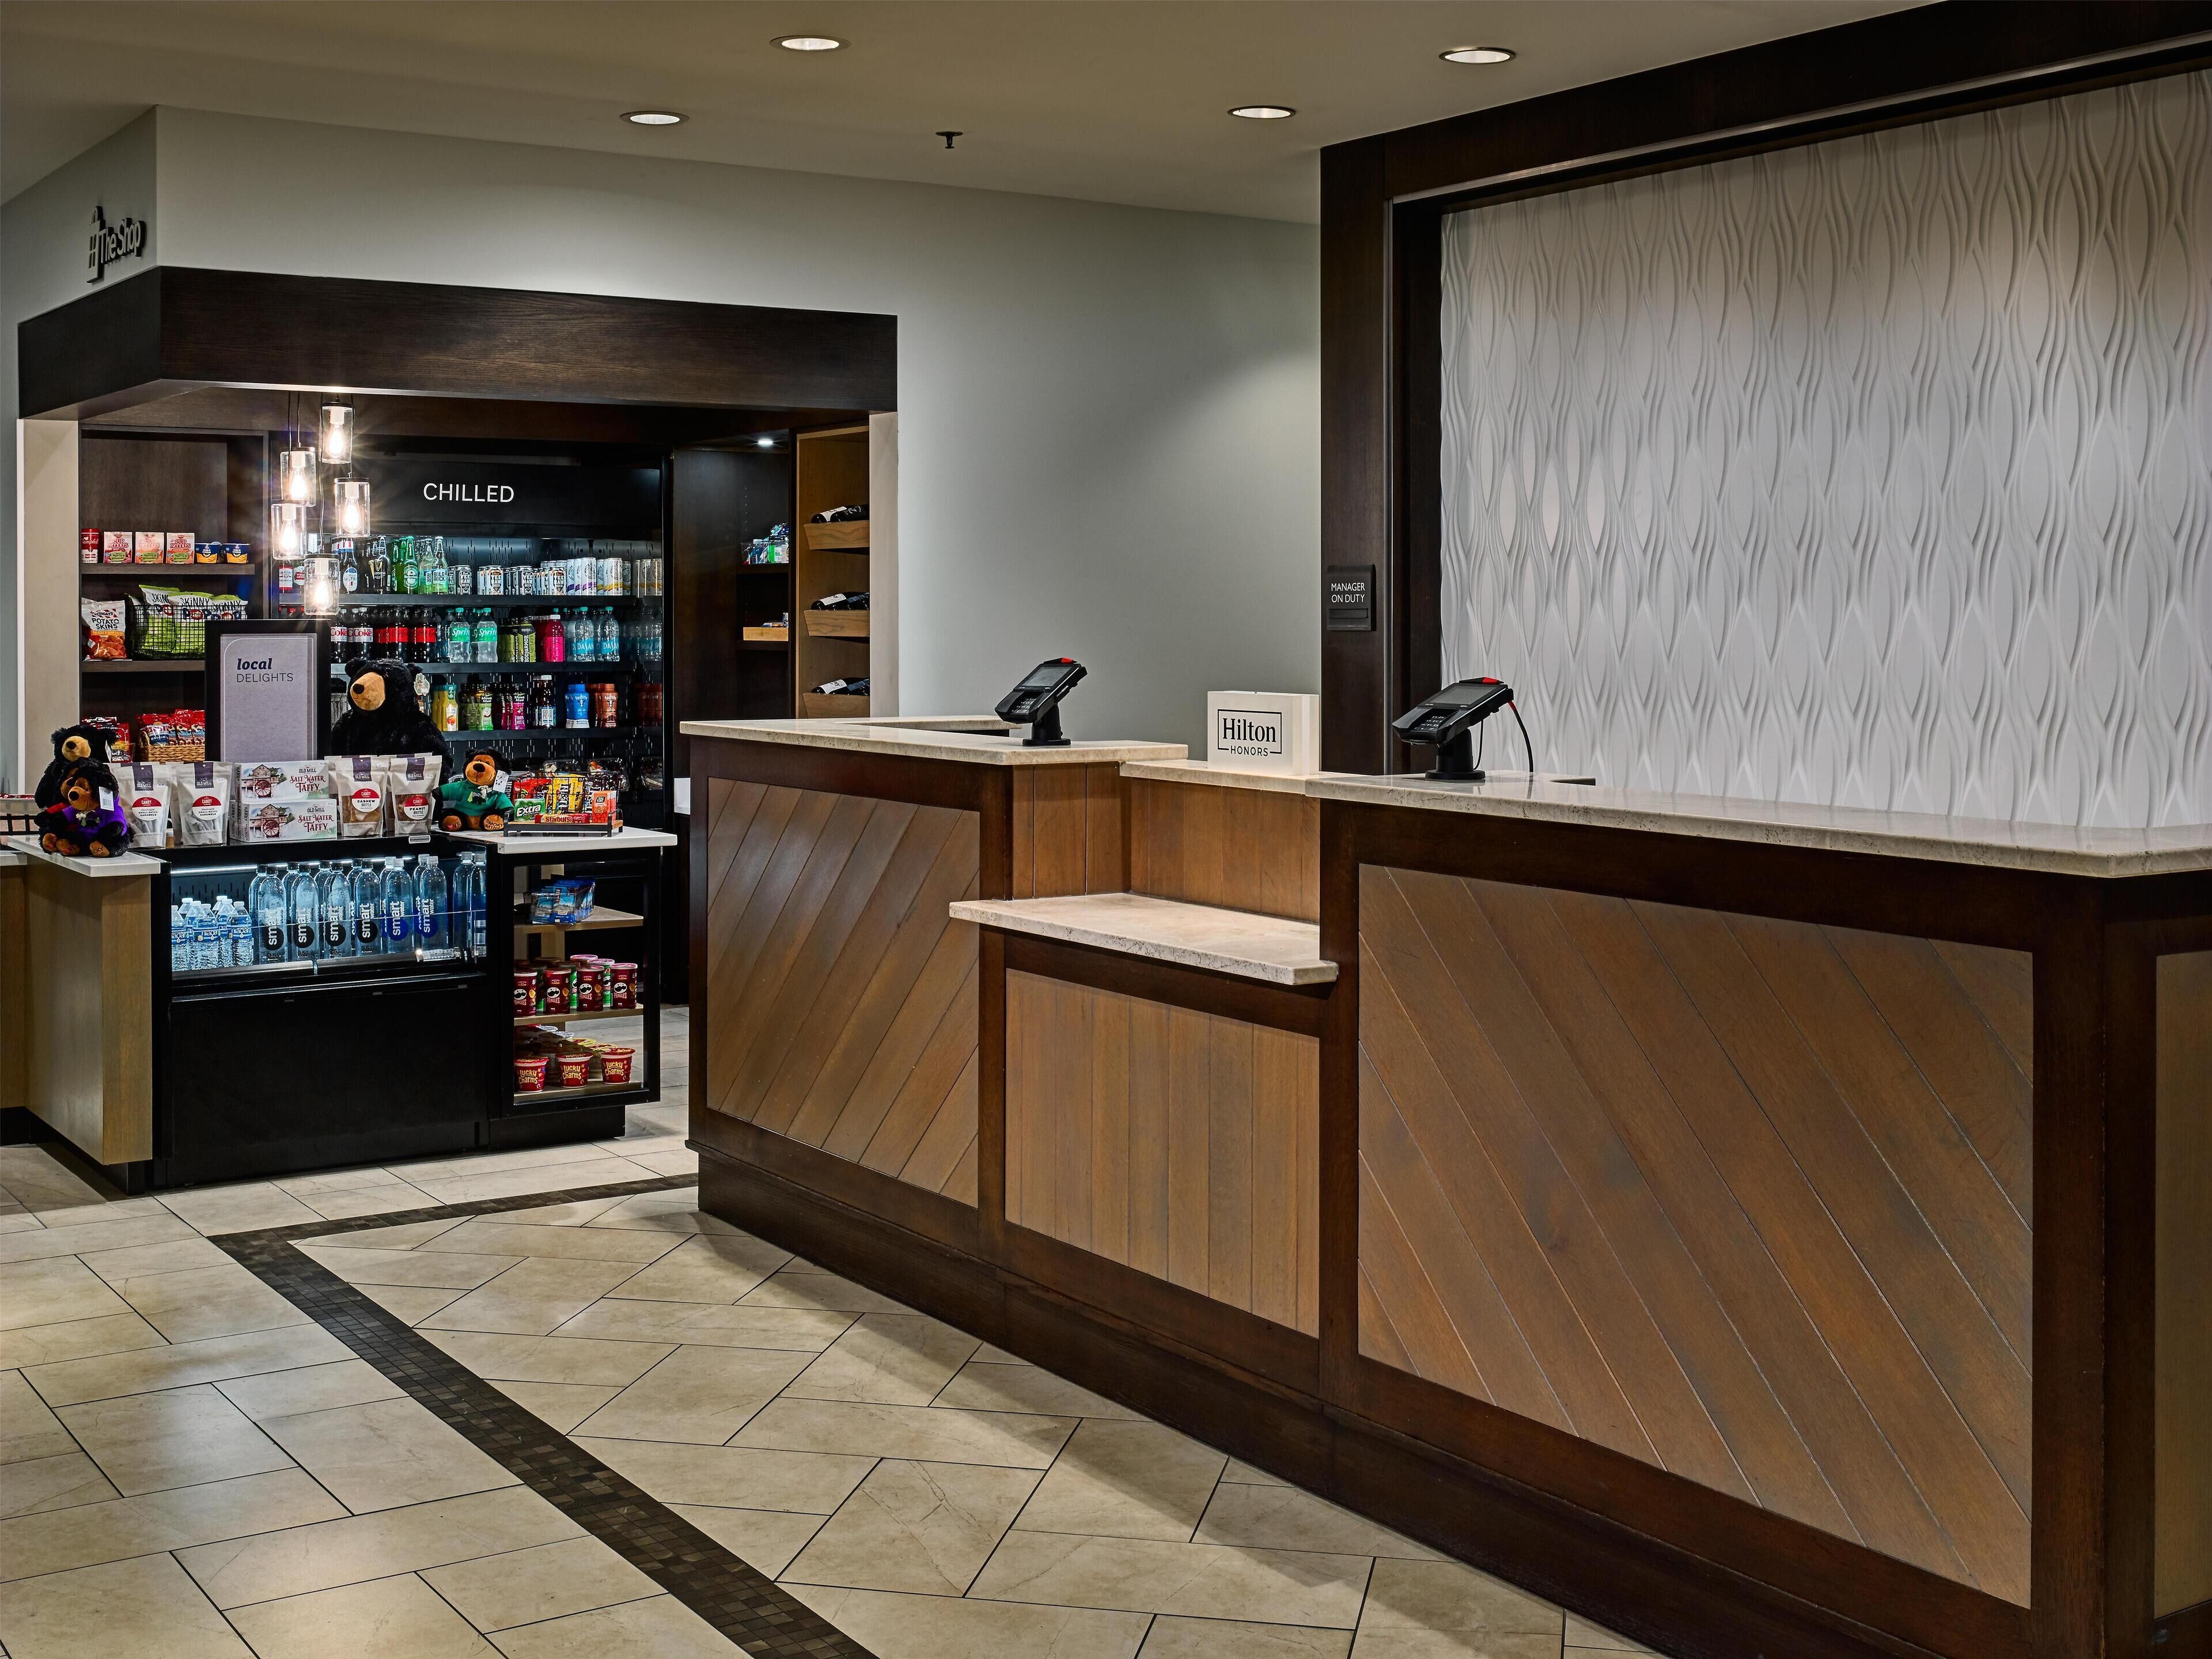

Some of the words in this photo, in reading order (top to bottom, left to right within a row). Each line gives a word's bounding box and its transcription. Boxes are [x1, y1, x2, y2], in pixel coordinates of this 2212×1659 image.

[99, 227, 117, 264] The
[117, 218, 145, 257] Shop
[423, 483, 514, 503] CHILLED
[1331, 582, 1365, 592] MANAGER
[1331, 594, 1343, 603] ON
[1345, 594, 1365, 603] DUTY
[183, 608, 211, 620] POP
[331, 628, 347, 637] Coke
[354, 628, 372, 637] Coke
[237, 658, 272, 670] local
[236, 673, 294, 683] DELIGHTS
[1222, 718, 1277, 743] Hilton
[1230, 745, 1268, 756] HONORS
[290, 775, 304, 783] SALT
[304, 775, 326, 783] WATER
[296, 782, 320, 793] TAFFY
[516, 804, 541, 817] Extra
[298, 815, 312, 823] SALT
[312, 814, 334, 823] WATER
[486, 819, 503, 827] SMOKY
[304, 821, 328, 832] TAFFY
[360, 903, 370, 938] smart
[390, 901, 401, 935] smart
[422, 898, 431, 933] smart
[563, 1065, 581, 1073] Lucky
[606, 1061, 623, 1069] Lucky
[520, 1069, 537, 1078] Lucky
[562, 1072, 581, 1080] Charms
[605, 1067, 624, 1076] Charms
[518, 1076, 538, 1084] Charms
